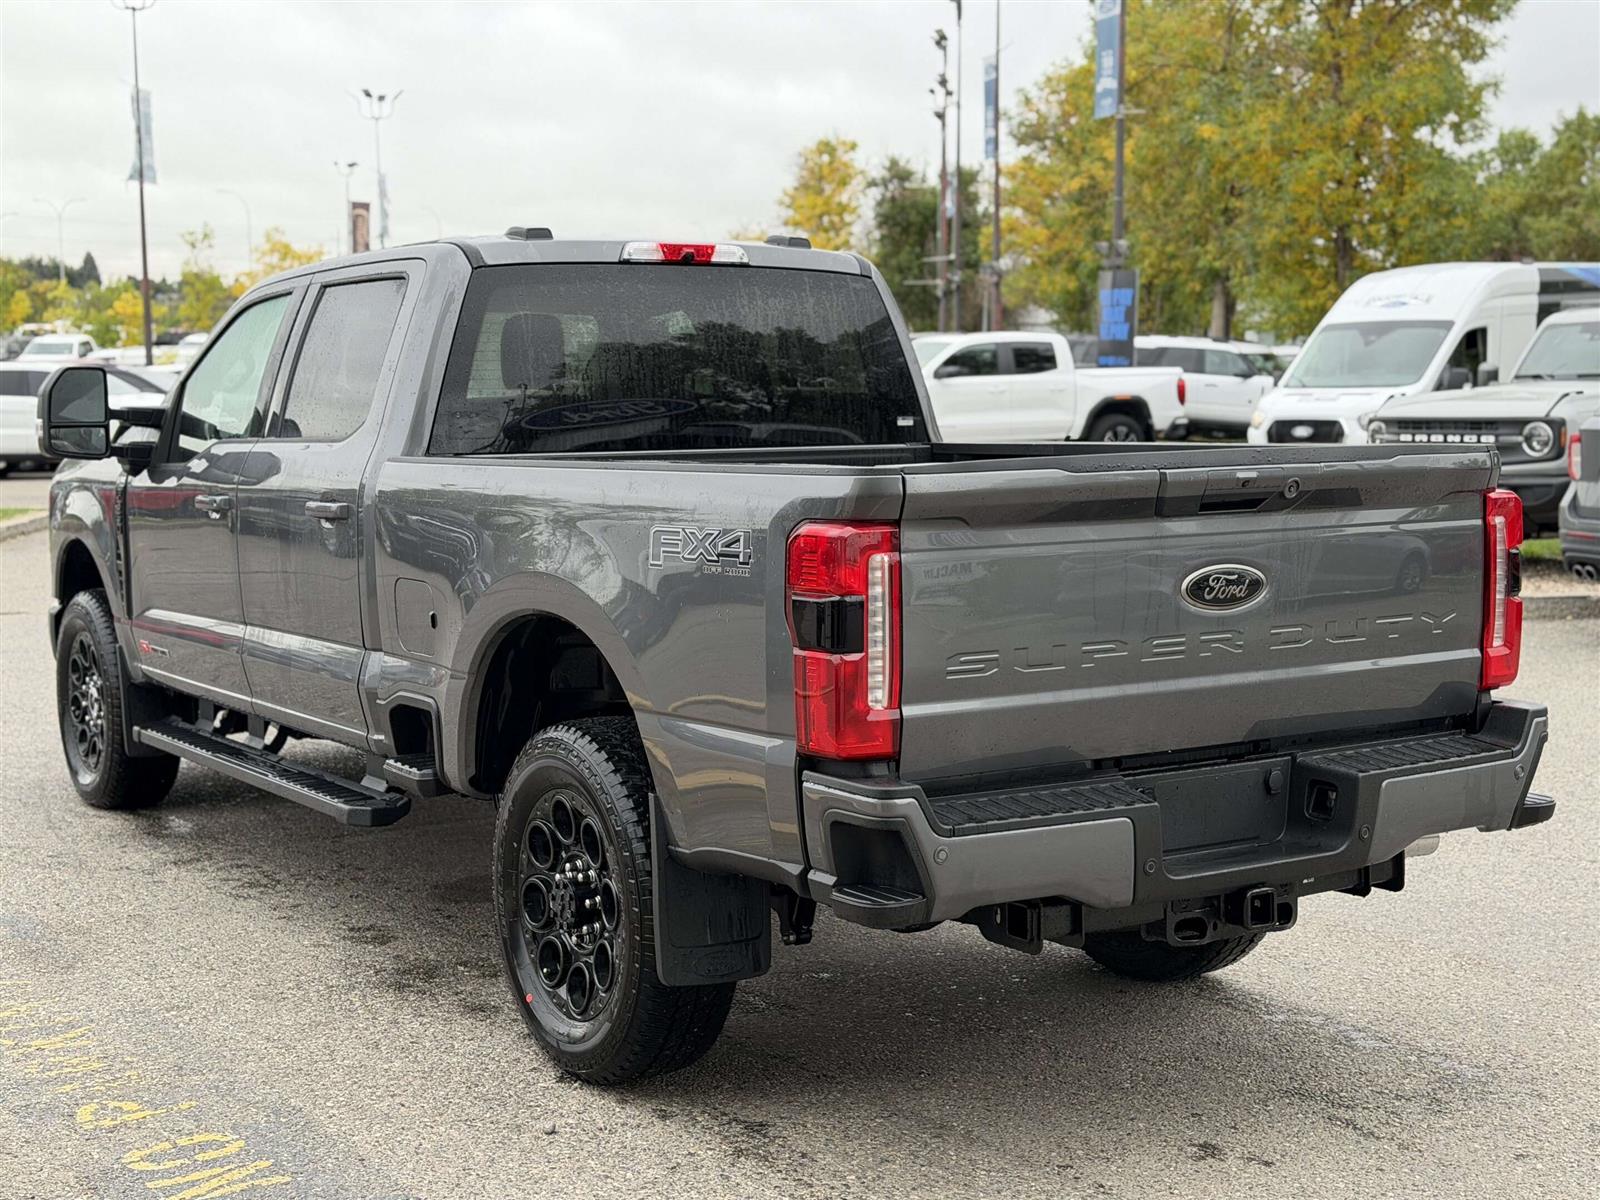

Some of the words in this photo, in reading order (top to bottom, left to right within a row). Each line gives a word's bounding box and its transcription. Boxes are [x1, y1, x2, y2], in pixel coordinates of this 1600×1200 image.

[1399, 434, 1496, 443] BRONCO
[648, 524, 754, 569] FX4
[1204, 574, 1250, 600] Ford
[945, 629, 1244, 681] SUPER
[1269, 610, 1458, 650] DUTY
